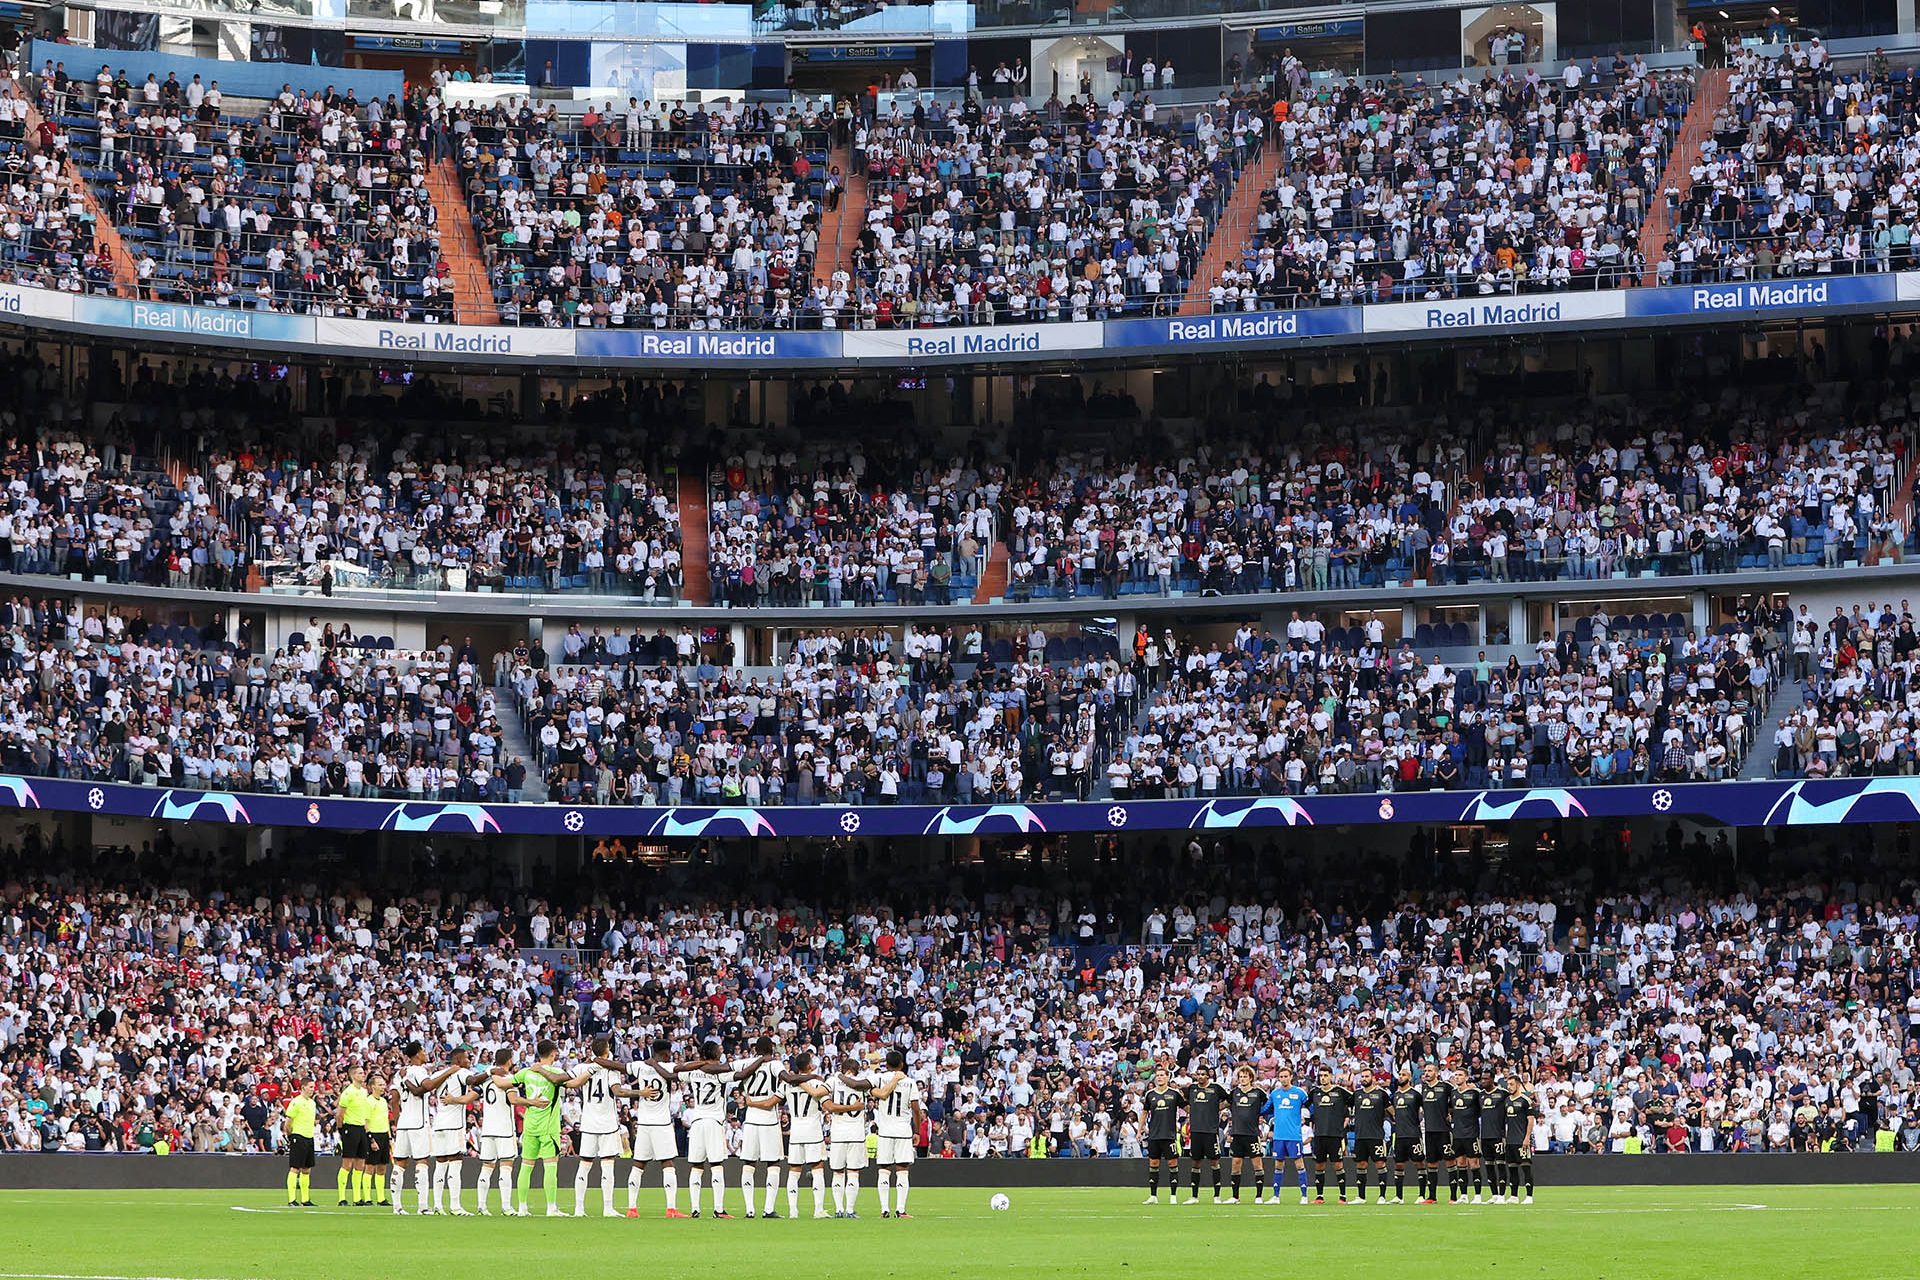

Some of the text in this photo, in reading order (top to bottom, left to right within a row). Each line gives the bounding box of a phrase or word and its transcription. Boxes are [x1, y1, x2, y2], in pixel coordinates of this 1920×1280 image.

[1297, 25, 1323, 34] Salida
[394, 38, 421, 48] Salida
[848, 48, 875, 56] Salida
[1694, 282, 1827, 309] Real Madrid
[134, 305, 249, 334] Real Madrid
[1427, 302, 1560, 327] Real Madrid
[1168, 315, 1296, 340] Real Madrid
[379, 329, 511, 353] Real Madrid
[643, 335, 775, 355] Real Madrid
[908, 332, 1039, 355] Real Madrid
[485, 1080, 497, 1105] 6
[587, 1077, 605, 1104] 14
[695, 1081, 717, 1105] 12
[746, 1070, 770, 1097] 22
[791, 1091, 813, 1118] 17
[838, 1090, 861, 1118] 10
[887, 1090, 902, 1117] 11
[1250, 1143, 1260, 1153] 33
[1296, 1143, 1302, 1154] 1
[1374, 1145, 1384, 1155] 29
[1412, 1144, 1422, 1154] 20
[1472, 1142, 1478, 1152] 6
[1494, 1142, 1503, 1153] 27
